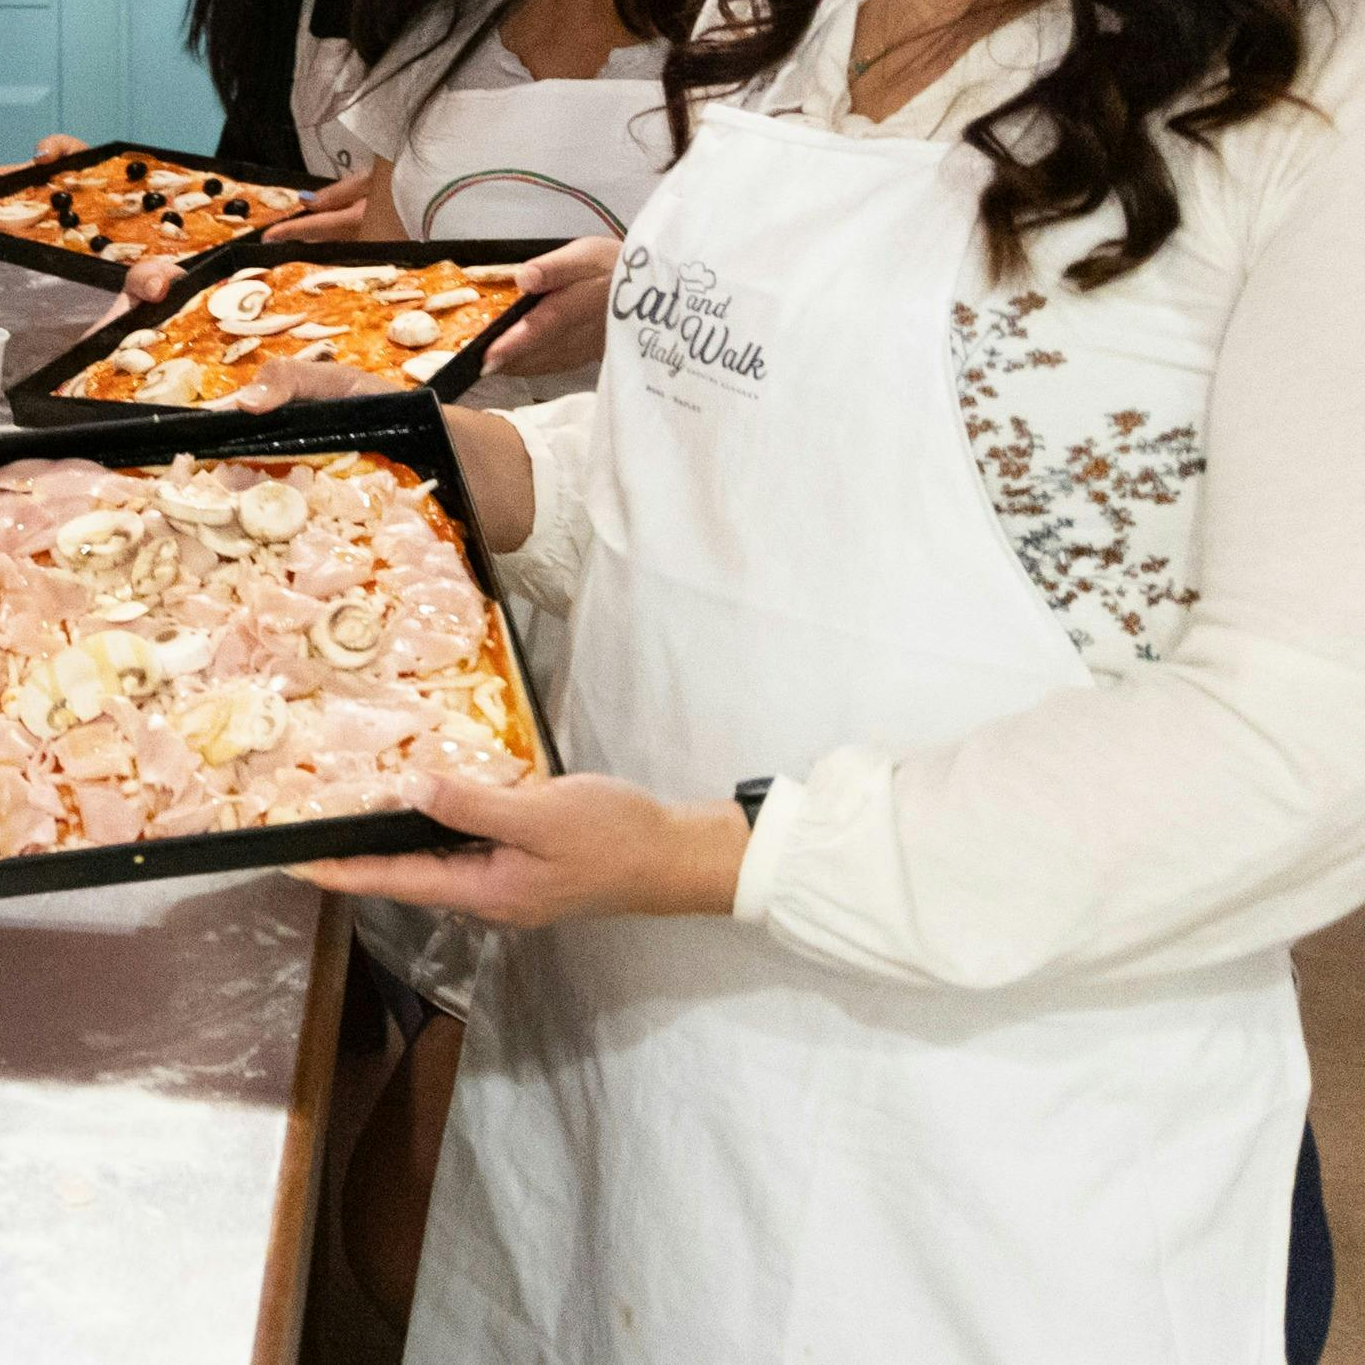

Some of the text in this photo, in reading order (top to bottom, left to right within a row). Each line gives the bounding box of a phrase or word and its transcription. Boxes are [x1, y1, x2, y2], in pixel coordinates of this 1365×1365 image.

[612, 246, 767, 381] Eat and Walk
[637, 327, 685, 378] Italy
